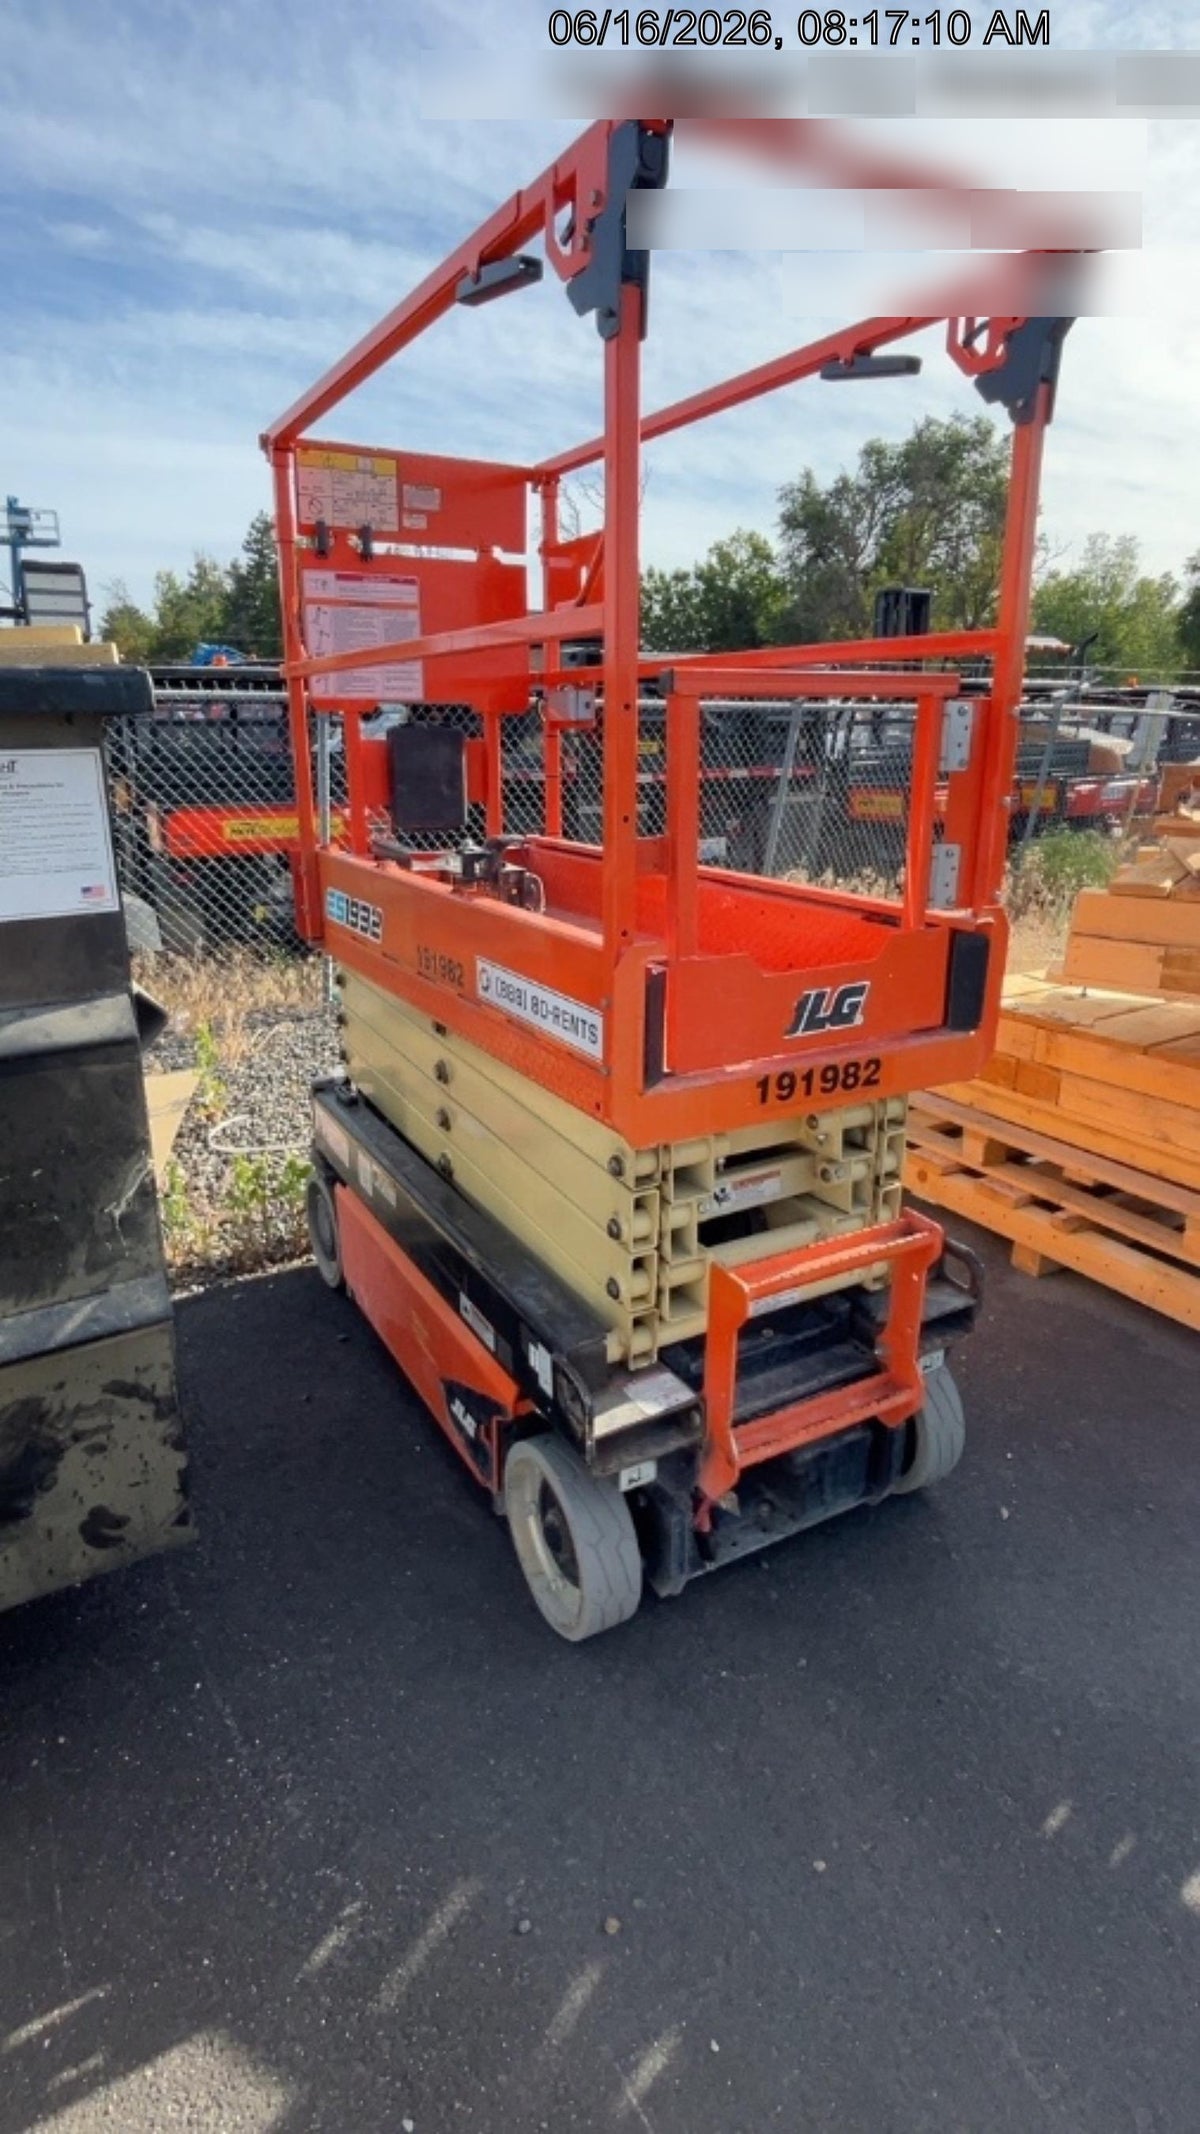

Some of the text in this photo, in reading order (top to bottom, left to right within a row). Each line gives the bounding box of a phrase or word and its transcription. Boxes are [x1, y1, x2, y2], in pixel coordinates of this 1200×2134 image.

[417, 945, 465, 988] 191982
[783, 981, 871, 1039] JLG
[755, 1058, 882, 1105] 191982
